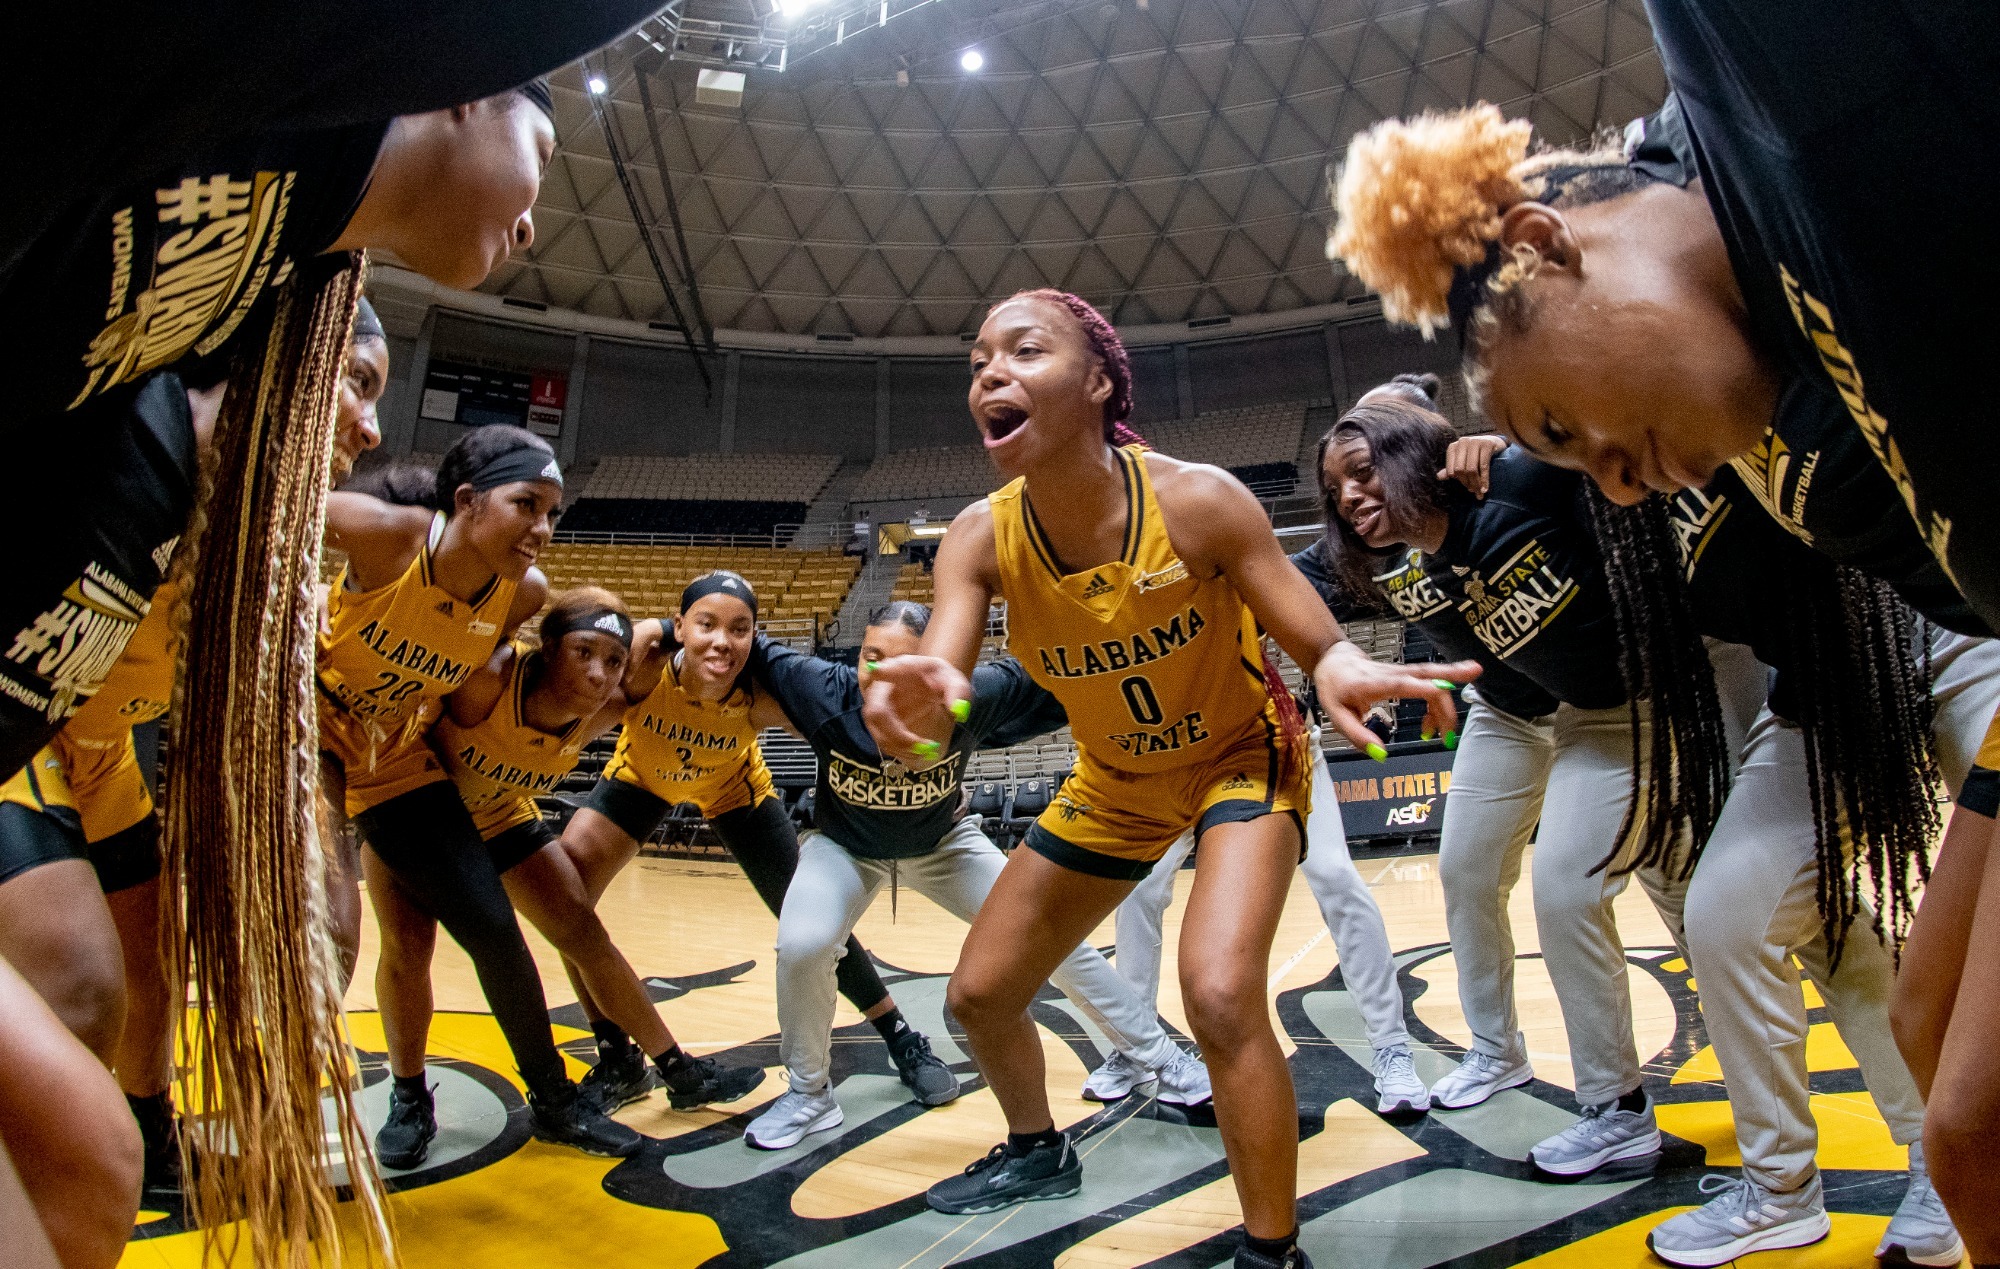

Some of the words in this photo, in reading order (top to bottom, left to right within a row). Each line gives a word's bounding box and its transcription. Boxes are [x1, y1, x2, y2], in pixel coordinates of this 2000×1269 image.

[1792, 450, 1821, 527] BASKETBALL
[84, 560, 129, 600] ALABAMA
[1498, 546, 1551, 597] STATE
[358, 619, 473, 687] ALABAMA
[1038, 603, 1206, 679] ALABAMA
[1119, 674, 1165, 726] 0
[642, 714, 739, 751] ALABAMA
[1107, 711, 1211, 758] STATE
[458, 744, 566, 791] ALABAMA
[828, 765, 958, 806] BASKETBALL
[829, 759, 915, 788] ALABAMA
[919, 756, 961, 783] STATE
[1221, 781, 1254, 791] adidas
[1382, 772, 1437, 799] STATE
